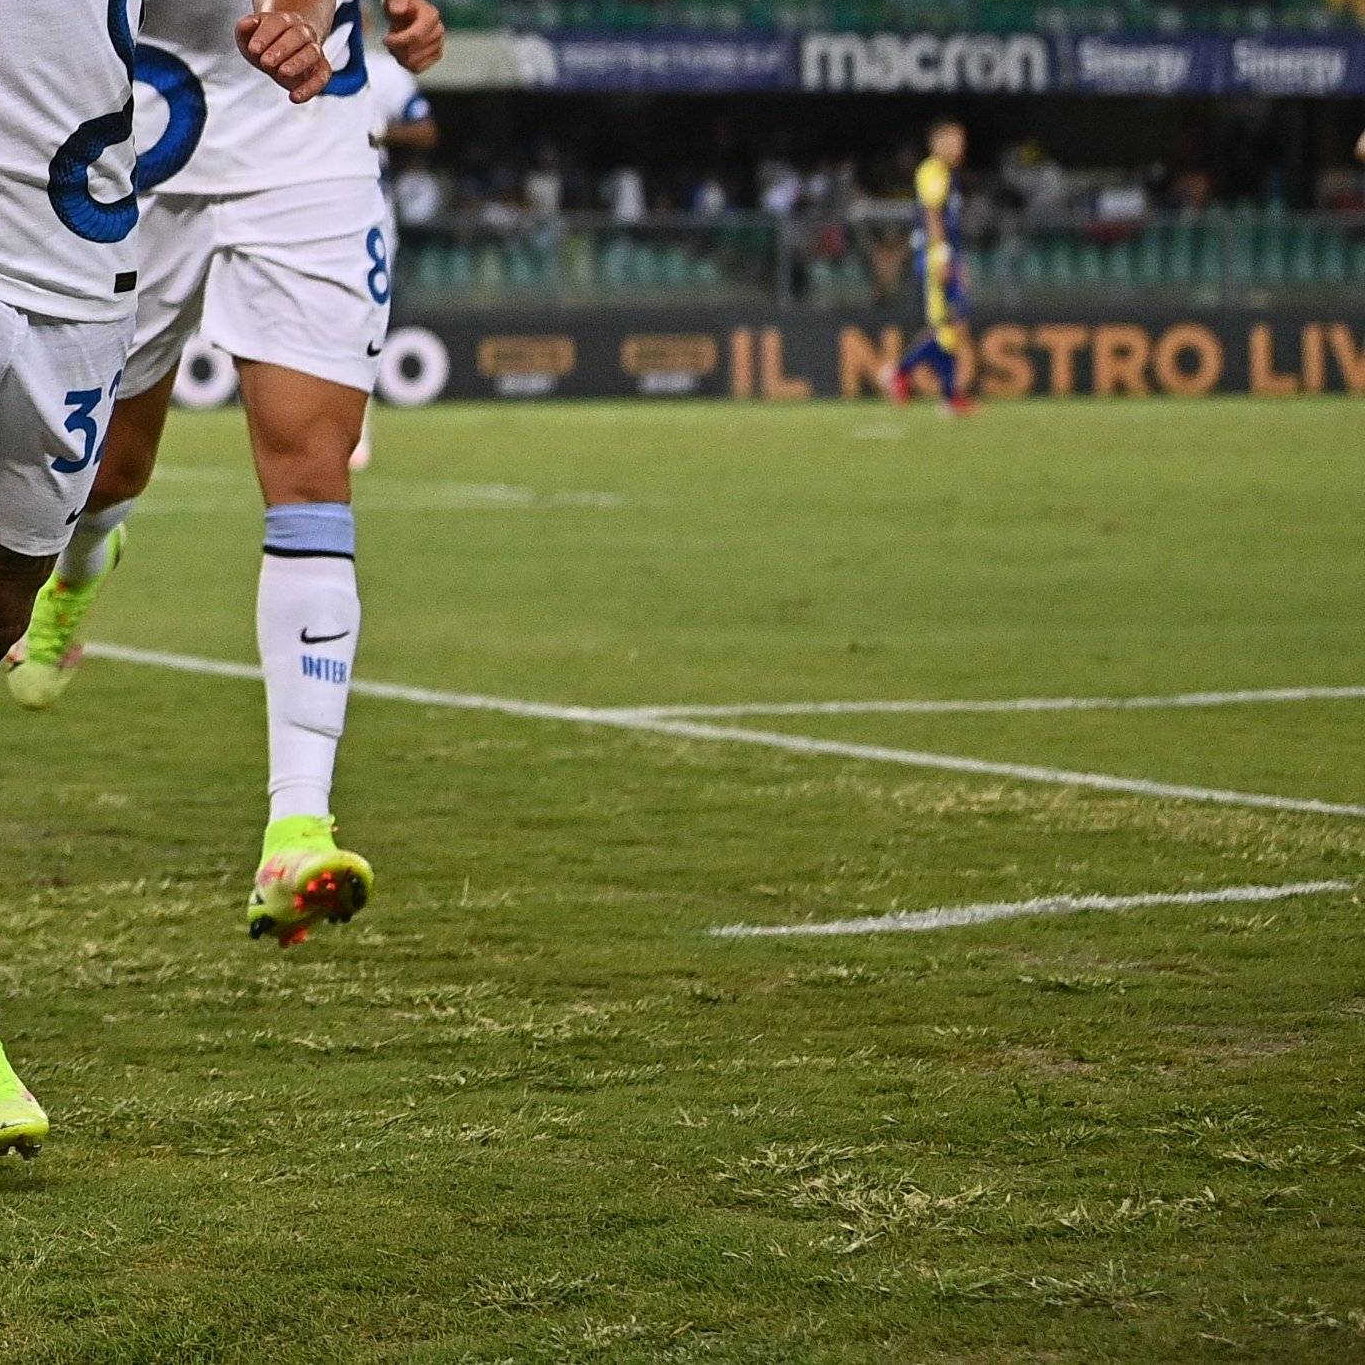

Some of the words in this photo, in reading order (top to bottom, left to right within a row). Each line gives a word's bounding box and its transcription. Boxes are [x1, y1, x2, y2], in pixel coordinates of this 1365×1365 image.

[800, 33, 1049, 91] macron
[366, 227, 390, 306] 8
[729, 325, 812, 397] IL
[51, 369, 122, 473] 3
[302, 655, 347, 684] INTER
